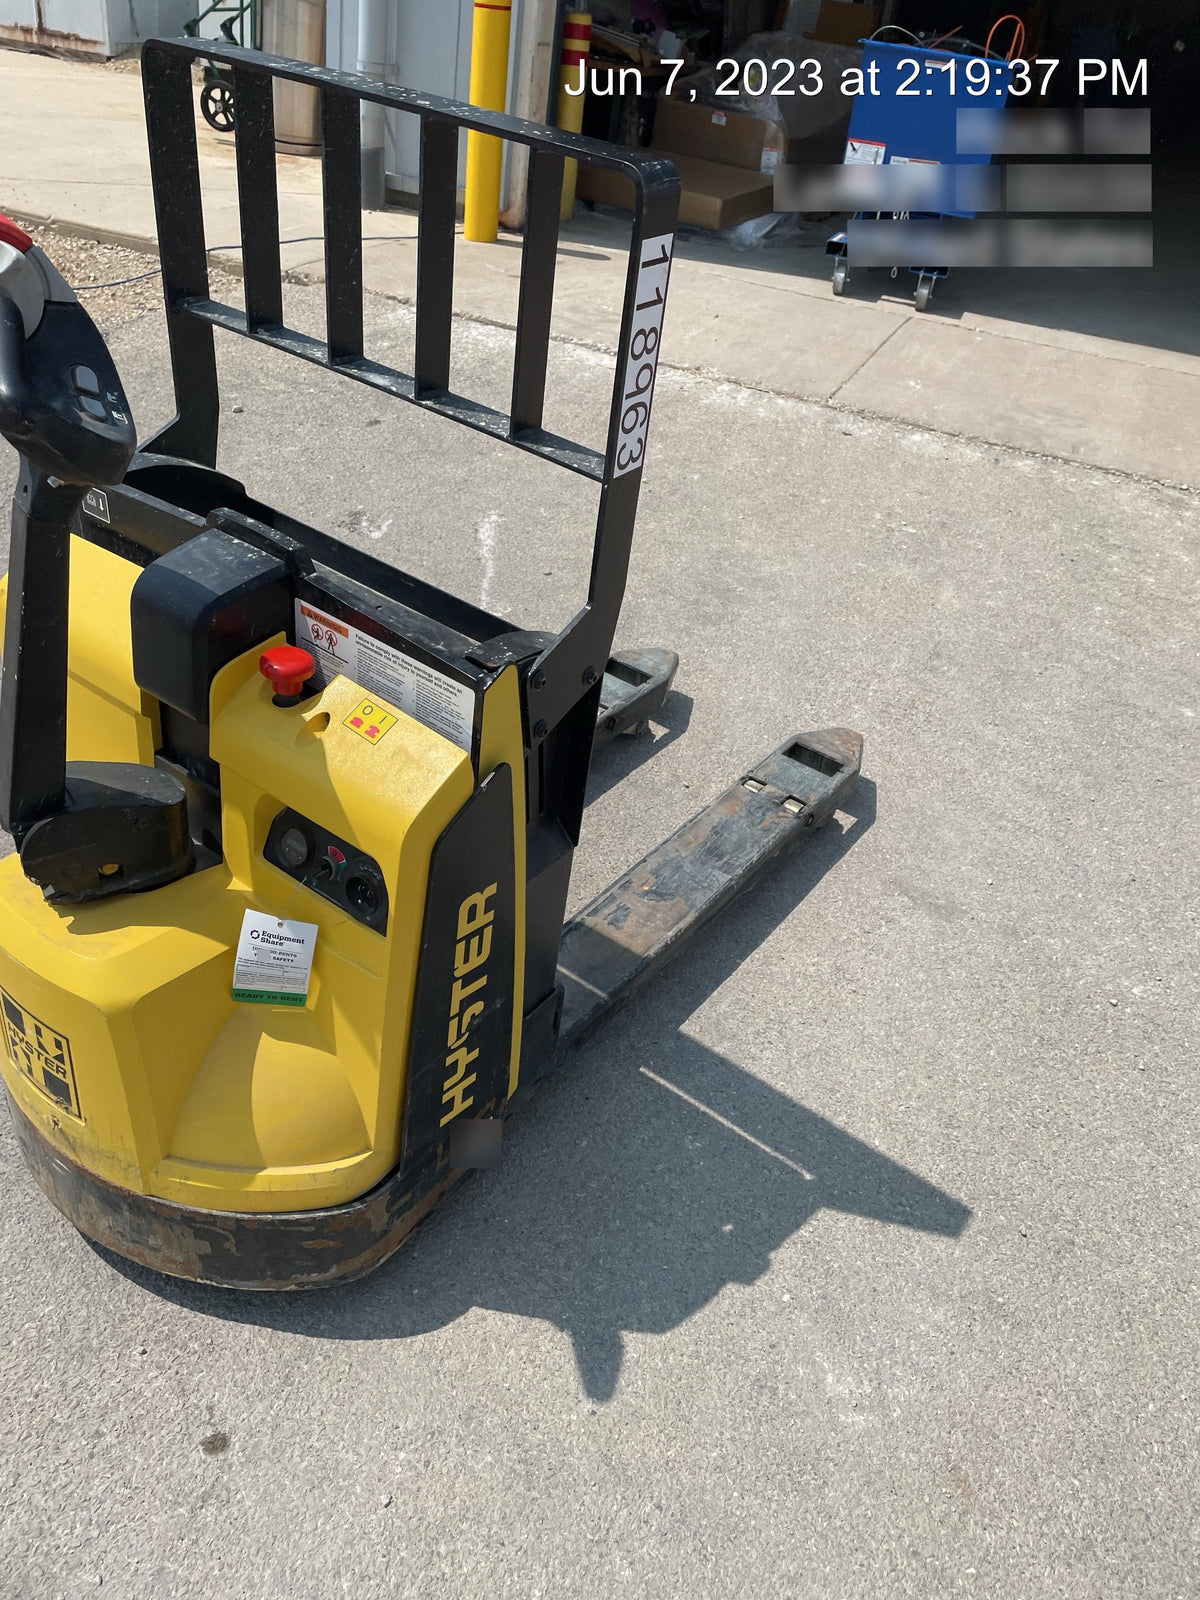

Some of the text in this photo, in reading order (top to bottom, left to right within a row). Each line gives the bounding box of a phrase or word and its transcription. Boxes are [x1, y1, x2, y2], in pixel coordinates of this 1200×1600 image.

[617, 244, 669, 471] 118963
[355, 633, 370, 646] Failure
[375, 643, 391, 657] comply
[391, 651, 401, 661] with
[401, 656, 413, 667] these
[413, 664, 433, 679] warnings
[433, 674, 442, 683] will
[442, 679, 456, 690] create
[383, 653, 392, 662] risk
[397, 661, 410, 673] injury
[415, 671, 433, 685] yourself
[433, 680, 443, 690] and
[442, 684, 458, 698] others.
[260, 936, 284, 947] Share
[261, 930, 305, 945] Equipment
[234, 992, 265, 1000] READY
[440, 881, 498, 1128] HYSTER
[8, 1021, 67, 1079] HYSTER
